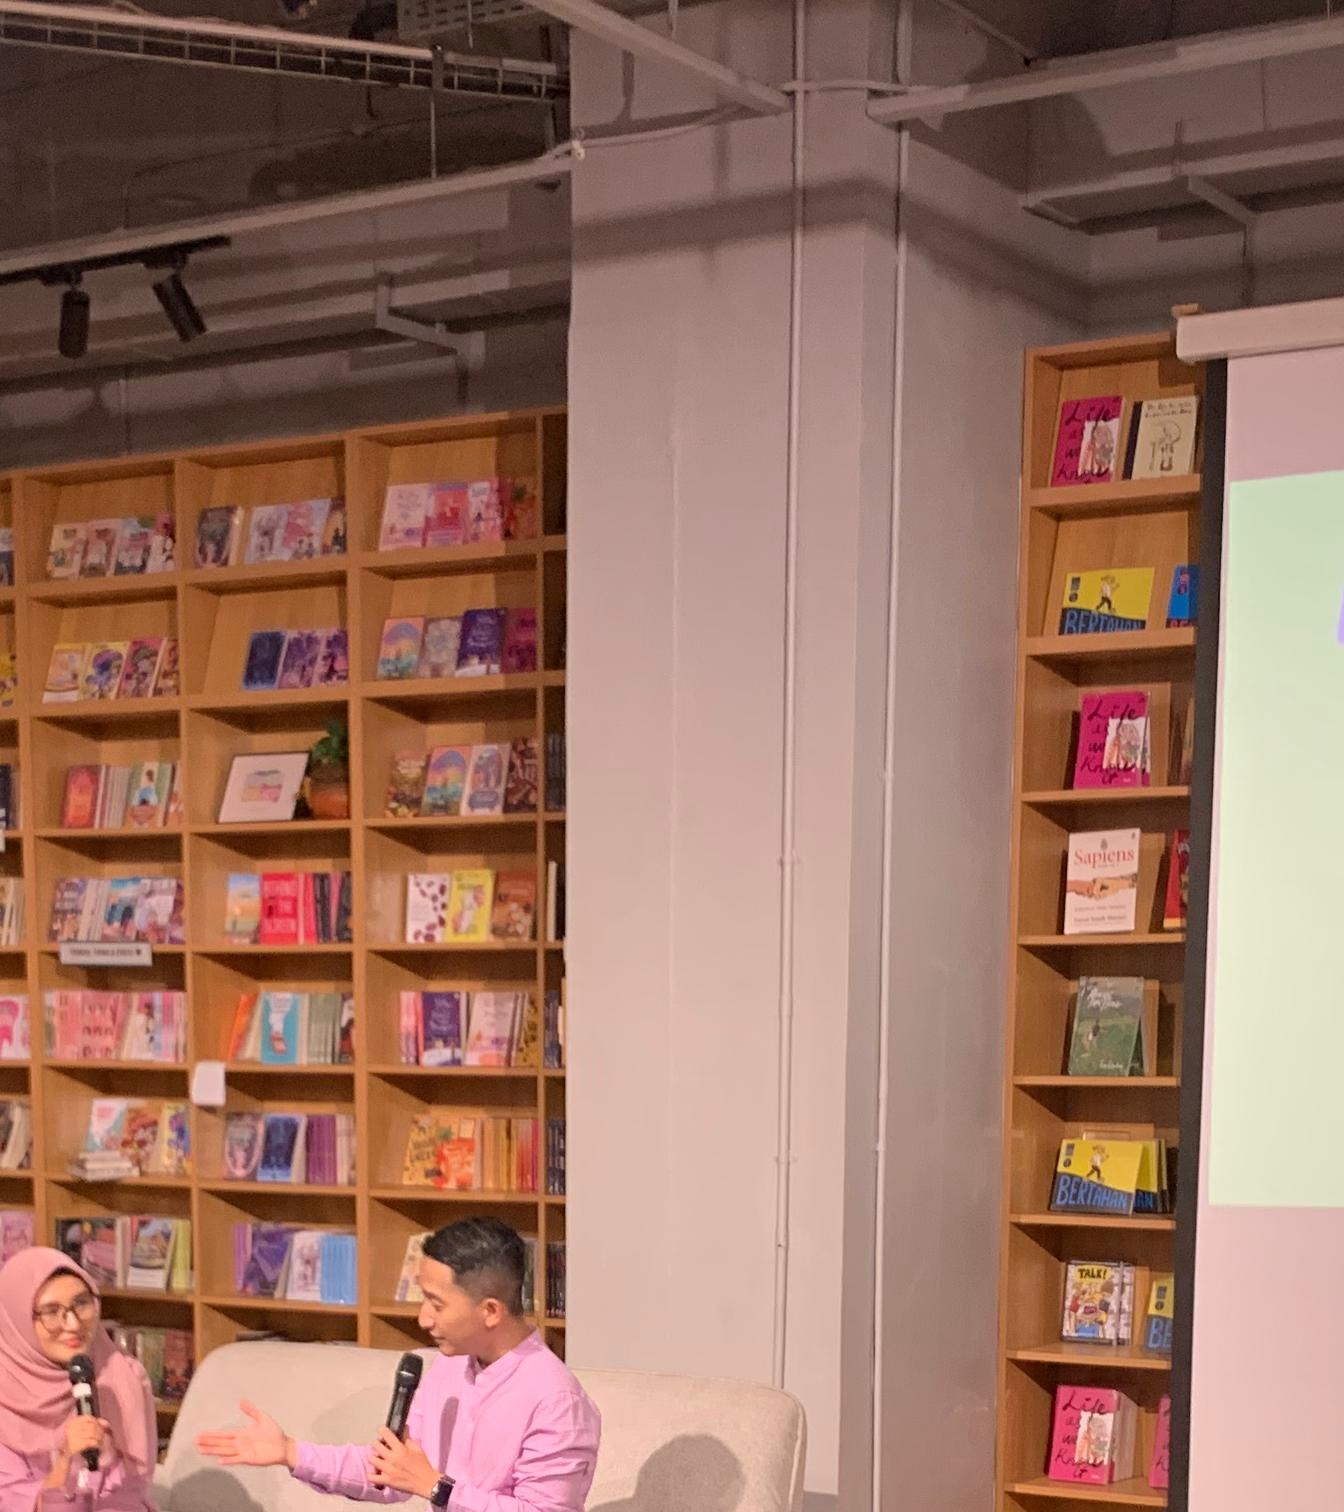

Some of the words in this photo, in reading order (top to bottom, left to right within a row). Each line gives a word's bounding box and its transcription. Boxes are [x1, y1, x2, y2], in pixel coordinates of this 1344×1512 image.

[1087, 699, 1147, 729] Life
[1074, 848, 1136, 868] Sapiens
[1056, 1175, 1128, 1209] BERTAHAN
[1078, 1268, 1107, 1279] TALK!
[1063, 1391, 1114, 1421] Life
